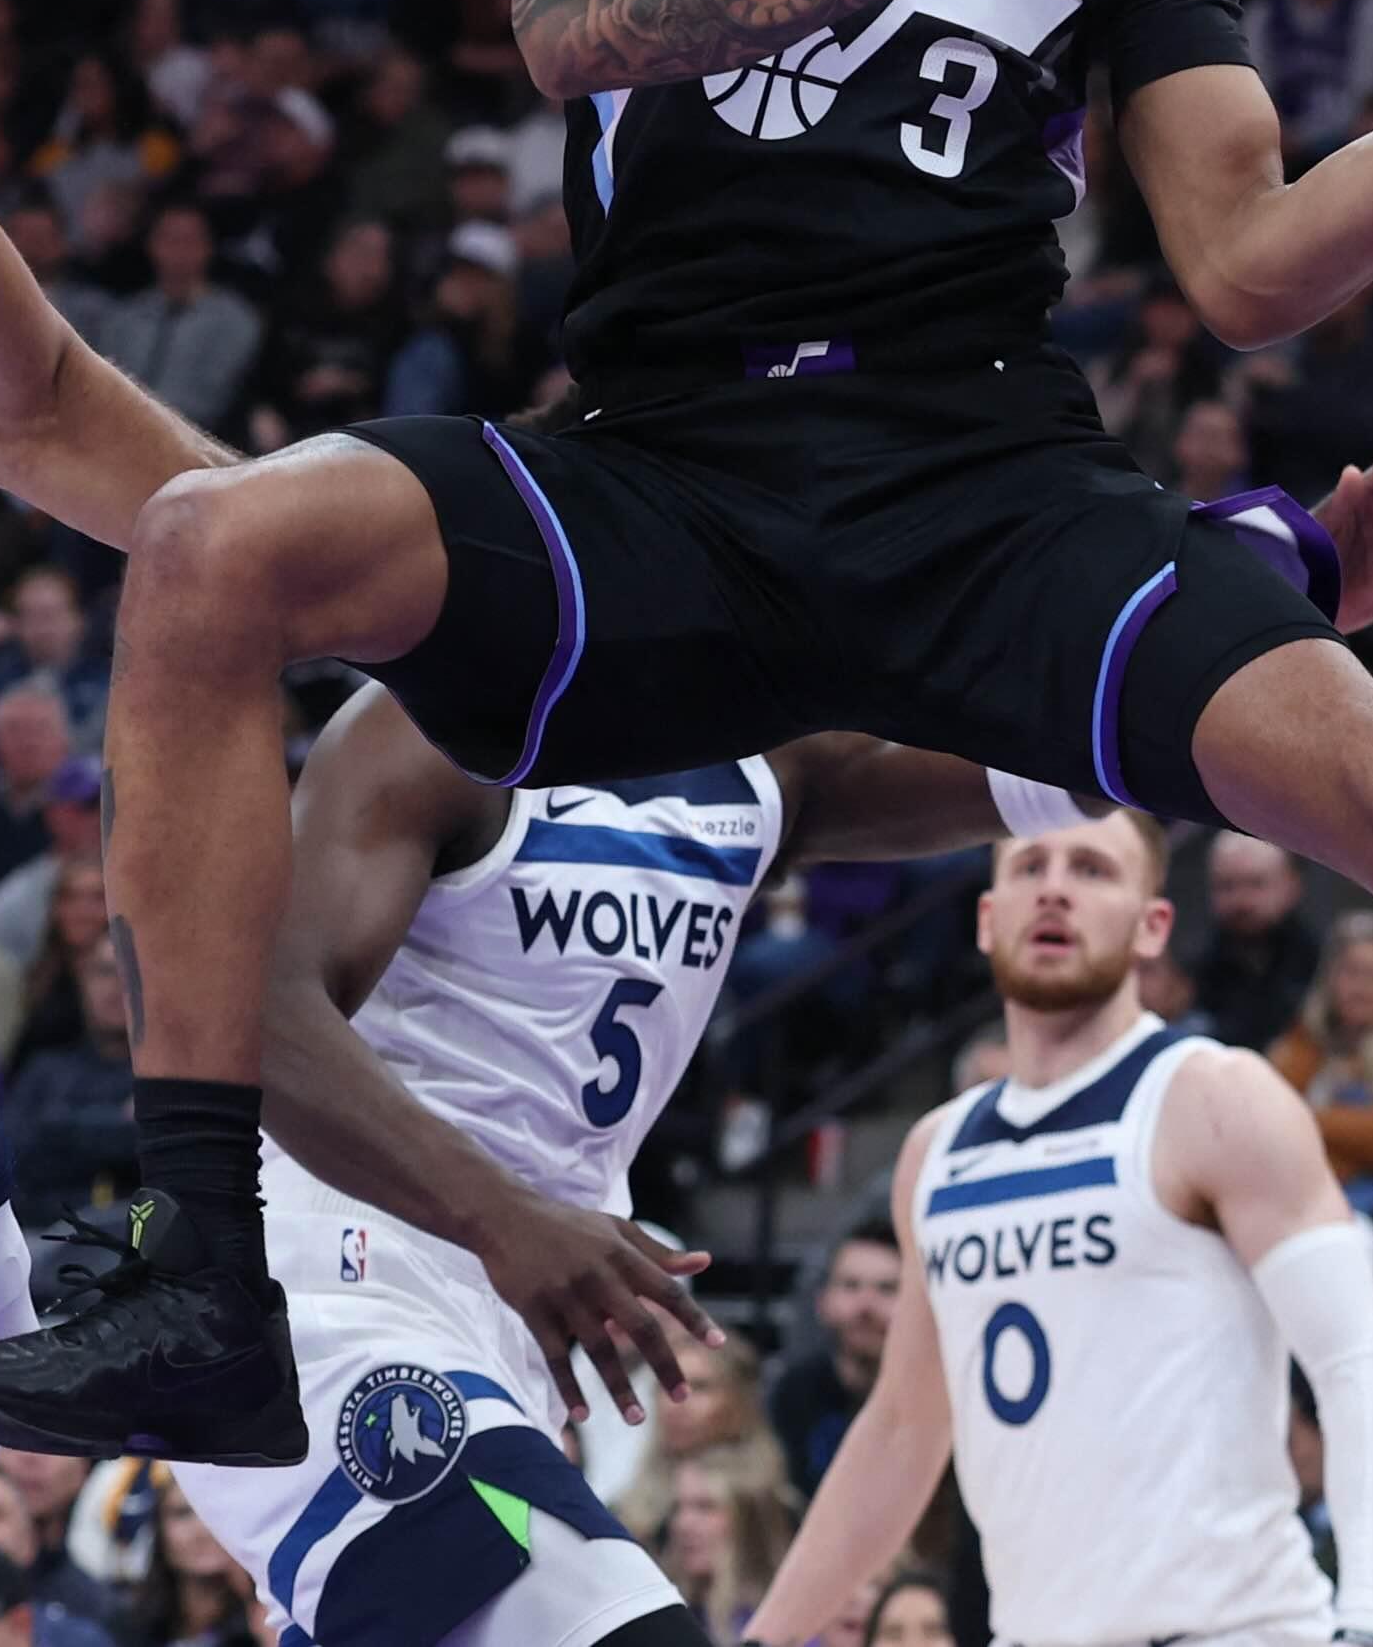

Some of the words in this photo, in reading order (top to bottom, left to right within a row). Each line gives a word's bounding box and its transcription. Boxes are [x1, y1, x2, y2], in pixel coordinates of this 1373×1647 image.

[900, 36, 998, 178] 3
[699, 816, 755, 836] ezzle
[510, 887, 733, 970] WOLVES
[582, 978, 665, 1128] 5
[924, 1214, 1117, 1284] WOLVES
[983, 1302, 1051, 1427] 0
[339, 1391, 373, 1489] MINNESOTA
[366, 1367, 464, 1439] TIMBERWOLVES
